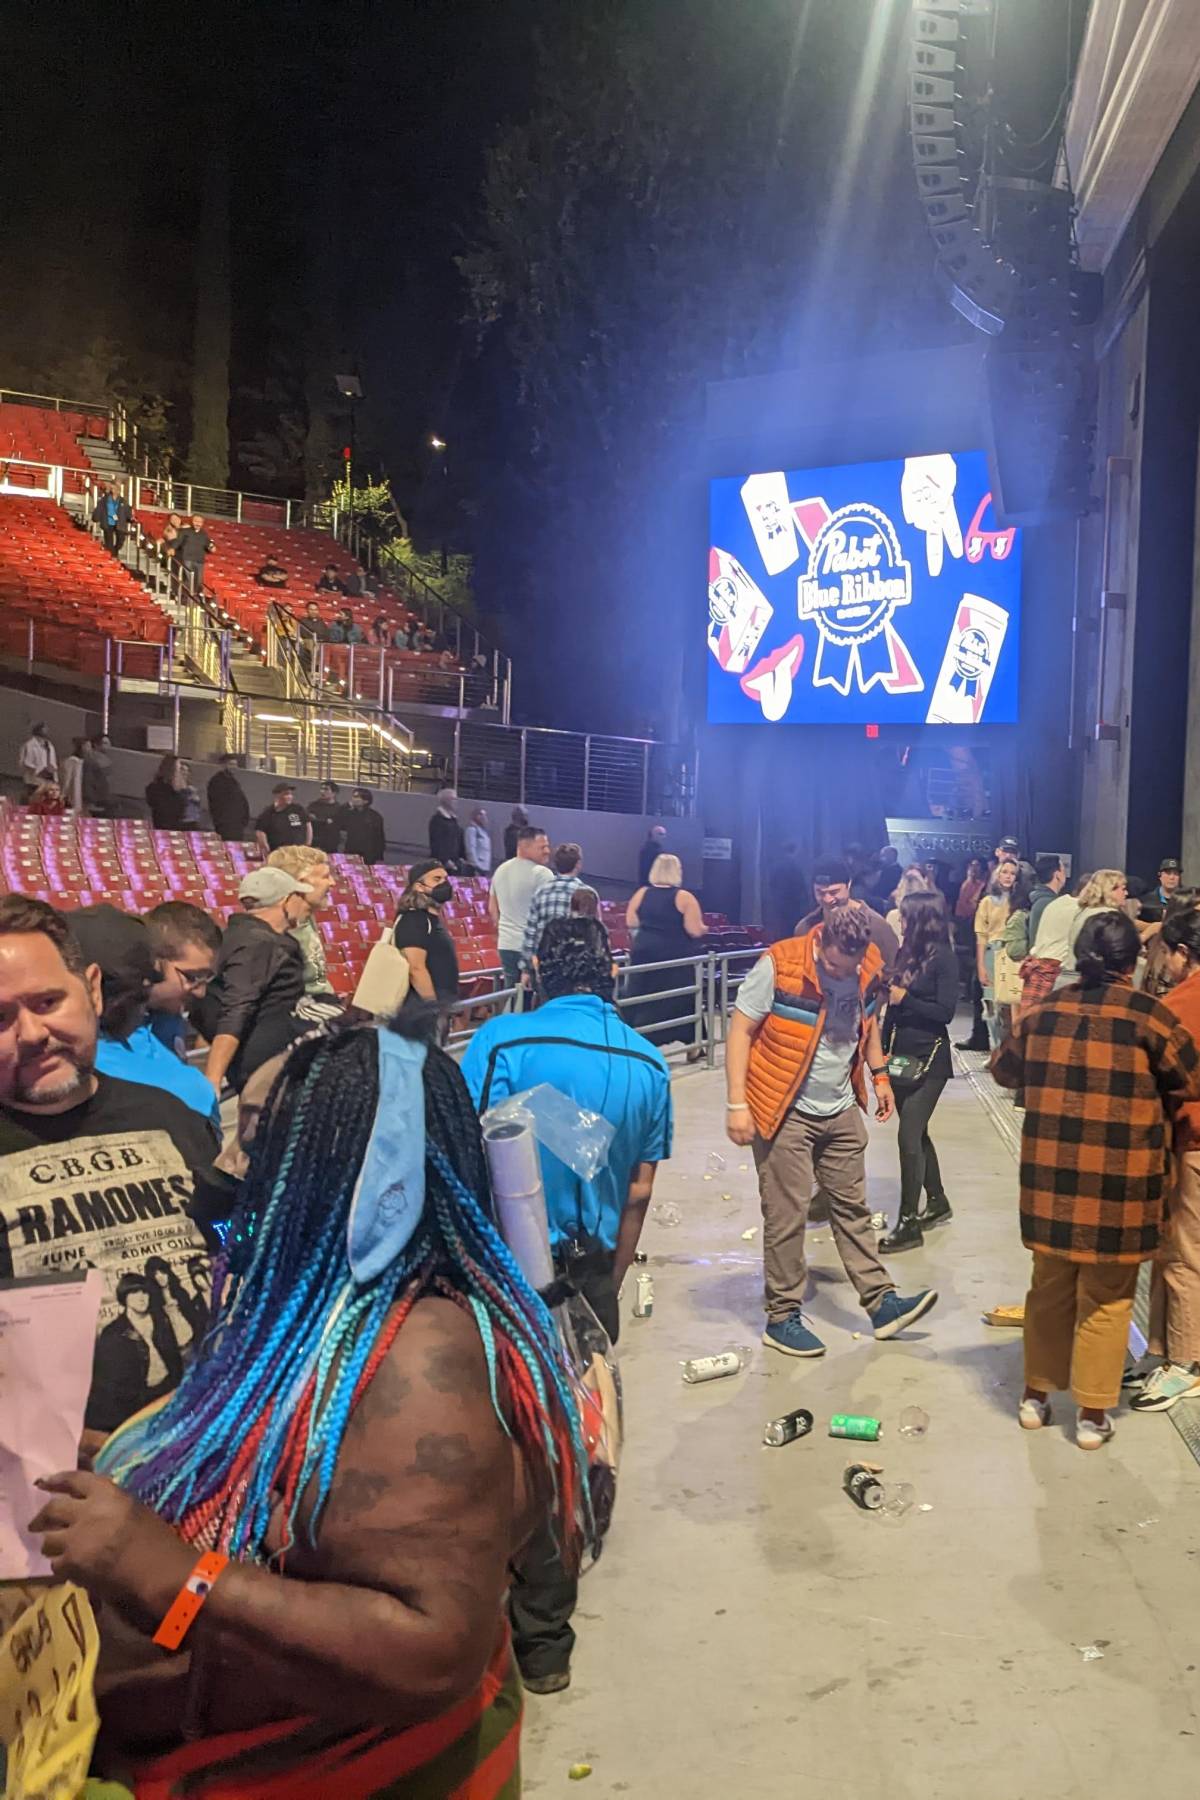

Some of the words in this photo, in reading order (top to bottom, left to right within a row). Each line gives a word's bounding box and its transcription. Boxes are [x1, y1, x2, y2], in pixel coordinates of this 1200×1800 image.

[822, 530, 883, 574] Pabst
[802, 580, 840, 612] Blue
[841, 570, 906, 605] Ribbon
[29, 1147, 150, 1184] C.B.G.B.
[17, 1174, 193, 1245] RAMONES
[42, 1246, 86, 1266] JUNE
[121, 1242, 164, 1260] ADMIT
